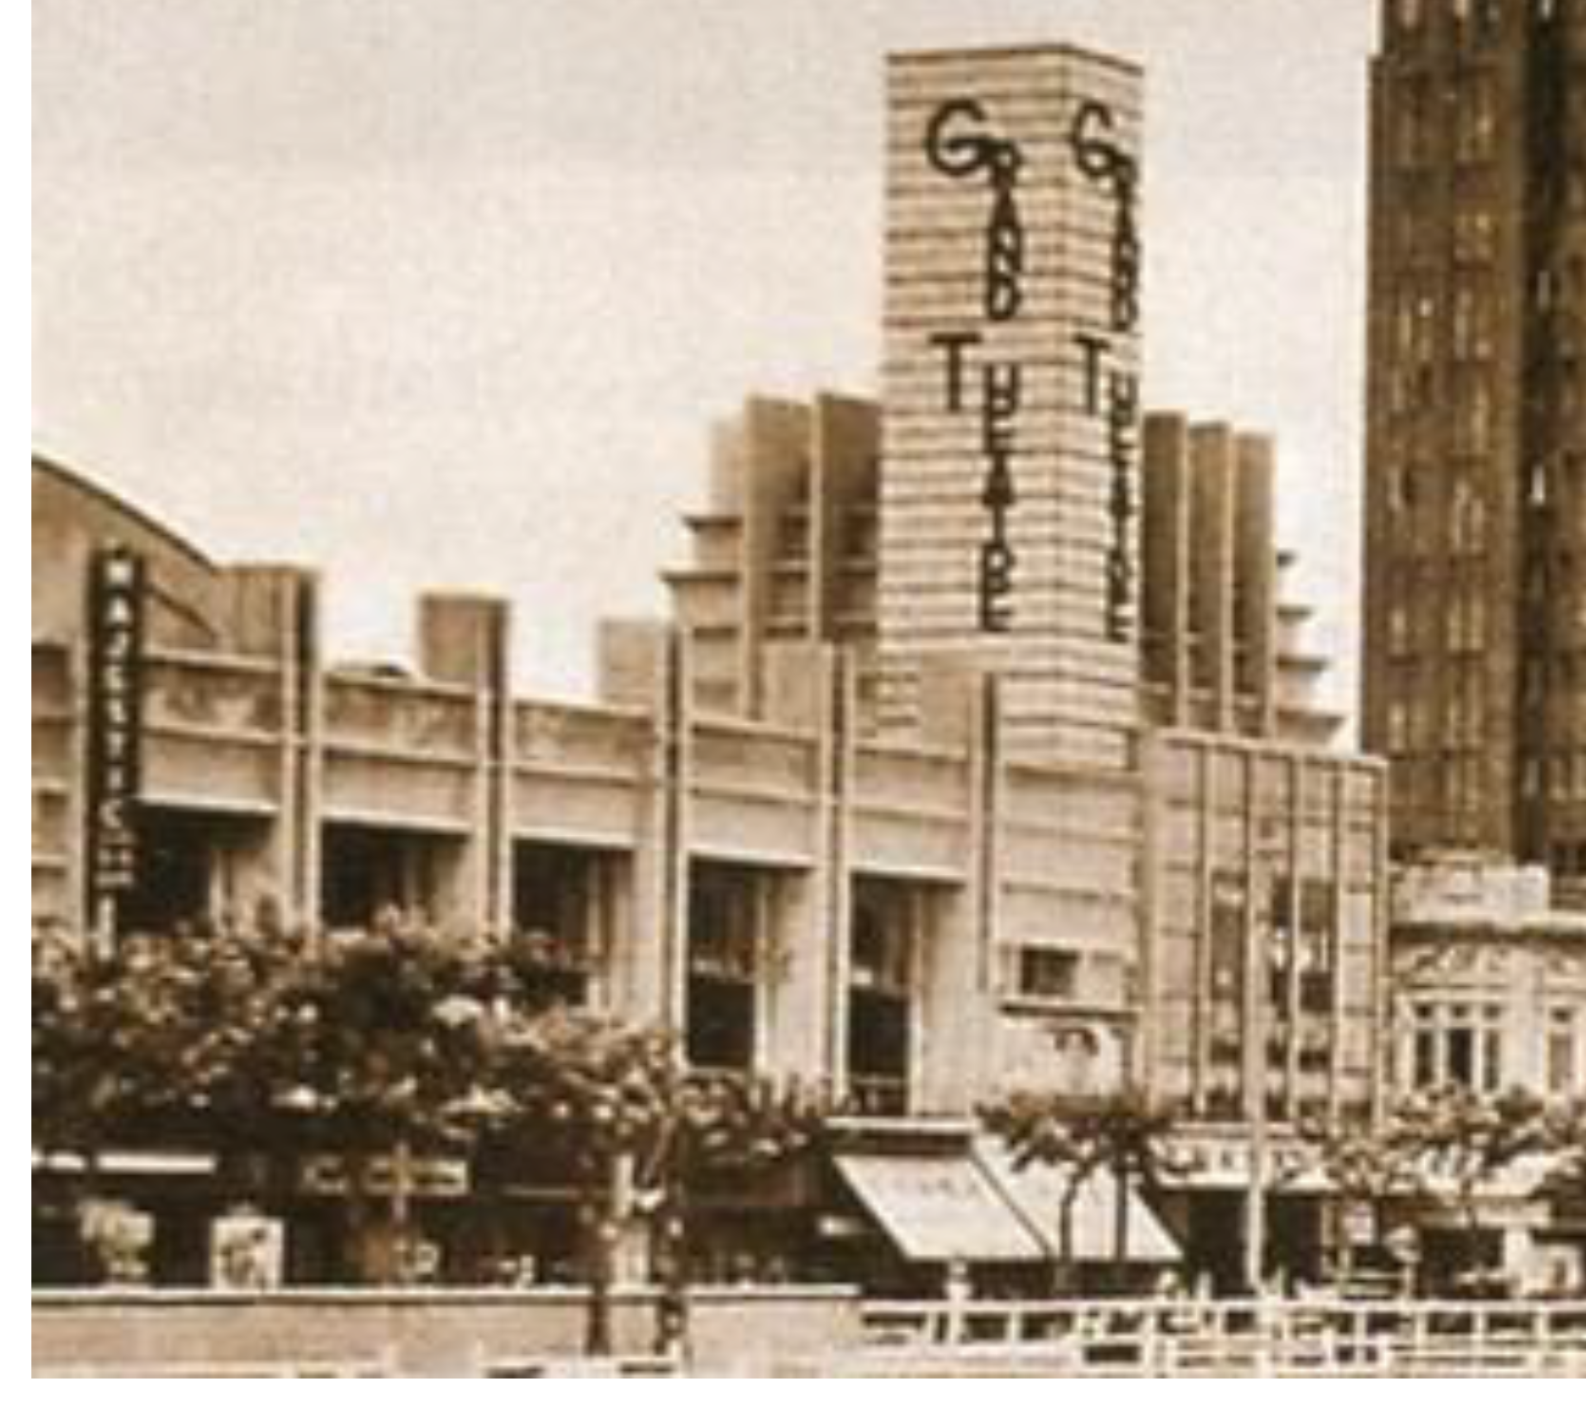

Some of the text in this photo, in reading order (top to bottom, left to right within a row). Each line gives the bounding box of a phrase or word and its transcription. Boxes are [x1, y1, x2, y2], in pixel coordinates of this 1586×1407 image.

[924, 96, 1024, 633] GRAND THEATRE
[1072, 97, 1141, 643] GRAND THEATRE
